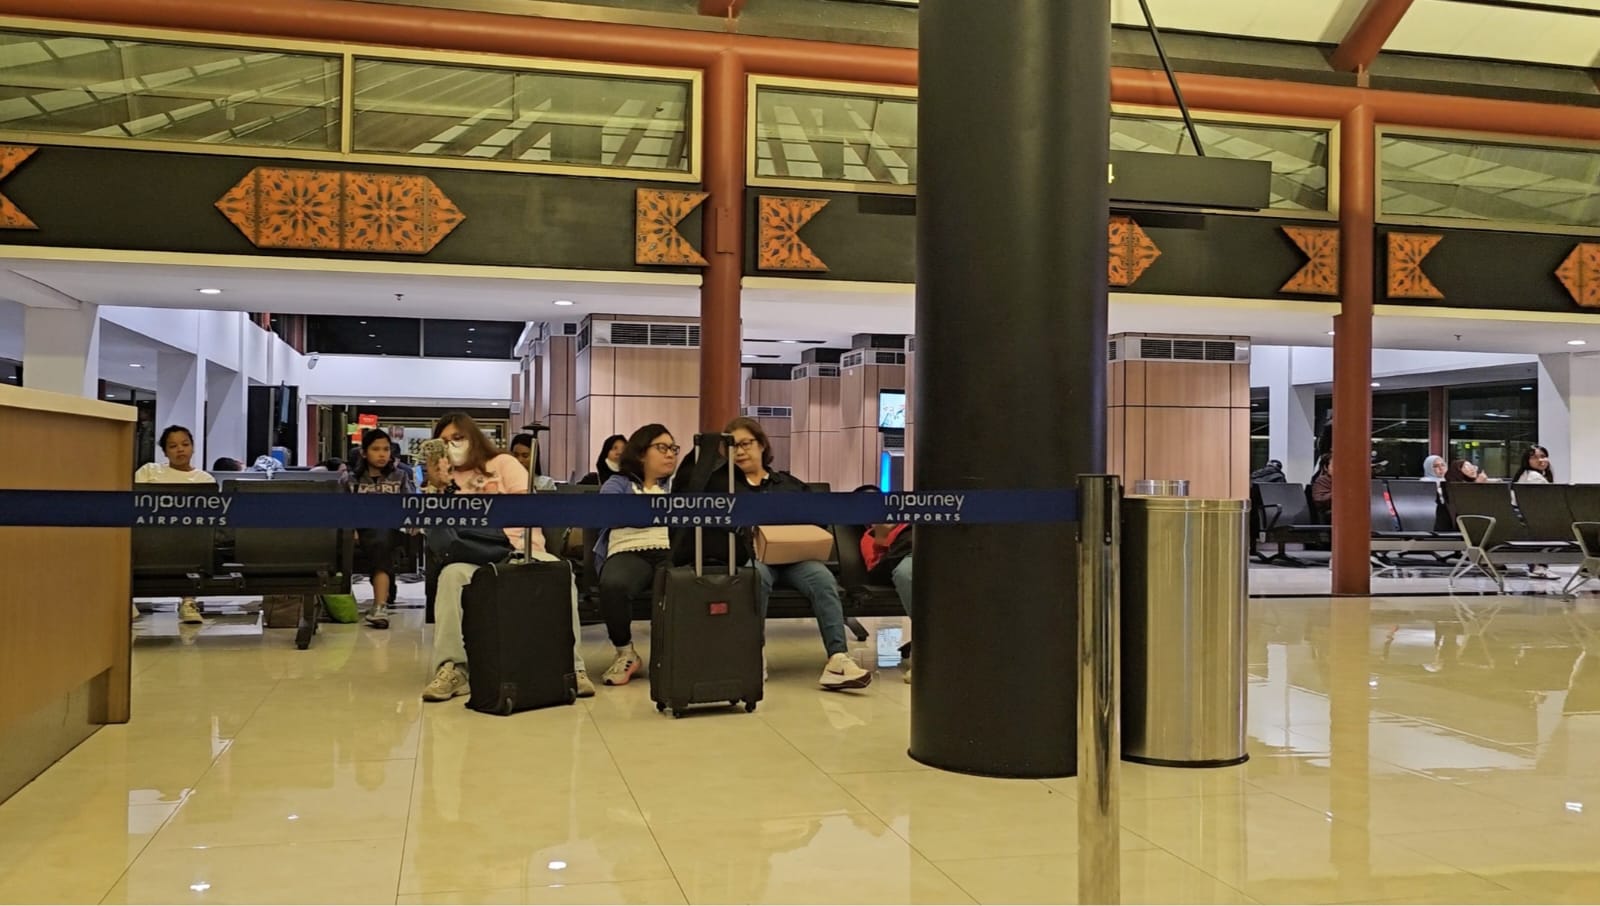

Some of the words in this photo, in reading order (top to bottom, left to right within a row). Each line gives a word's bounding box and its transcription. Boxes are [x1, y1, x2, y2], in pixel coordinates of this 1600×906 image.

[134, 494, 232, 514] injourney
[402, 496, 493, 515] injourney
[651, 496, 736, 514] injourney
[884, 494, 965, 511] injourney
[136, 516, 227, 526] AIRPORTS
[403, 517, 488, 526] AIRPORTS
[653, 516, 732, 525] AIRPORTS
[886, 513, 961, 522] AIRPORTS
